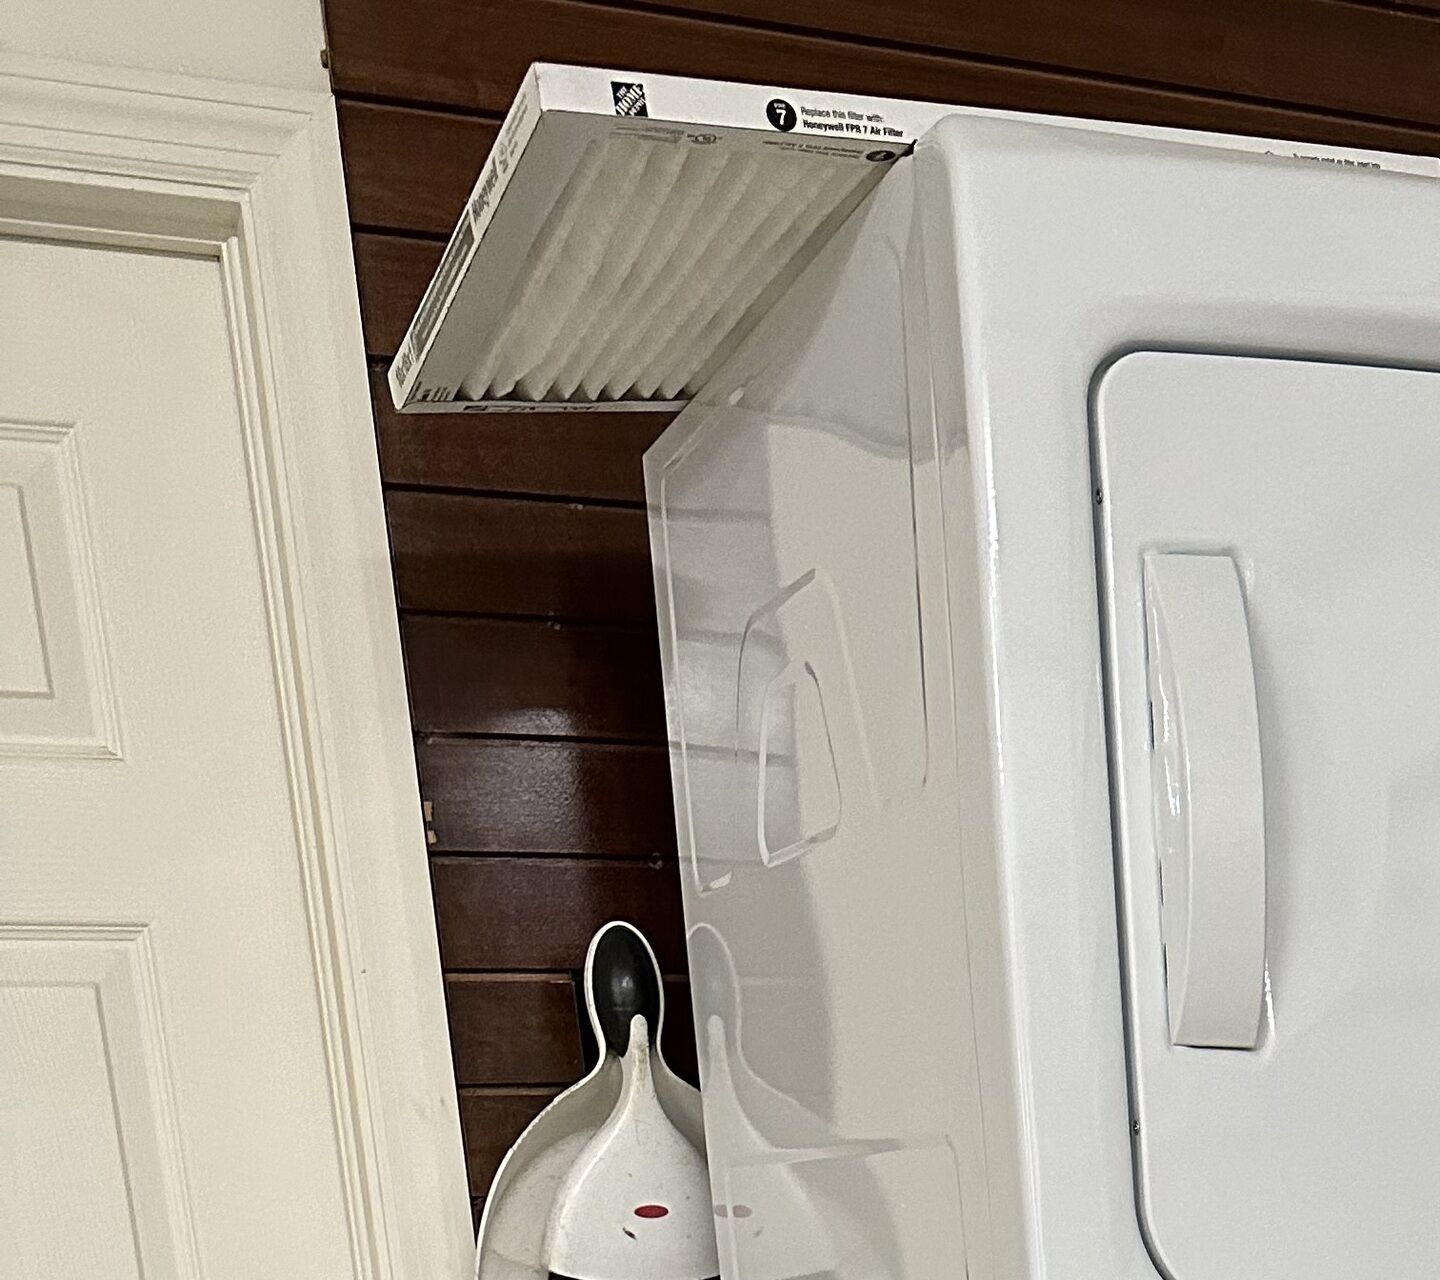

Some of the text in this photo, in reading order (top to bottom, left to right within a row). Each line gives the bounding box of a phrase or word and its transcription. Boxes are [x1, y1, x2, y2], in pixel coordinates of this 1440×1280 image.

[615, 84, 643, 117] HOME
[776, 109, 786, 126] 7
[801, 106, 831, 118] Replace
[803, 119, 904, 137] Honeywell FPR 7 Air Filter
